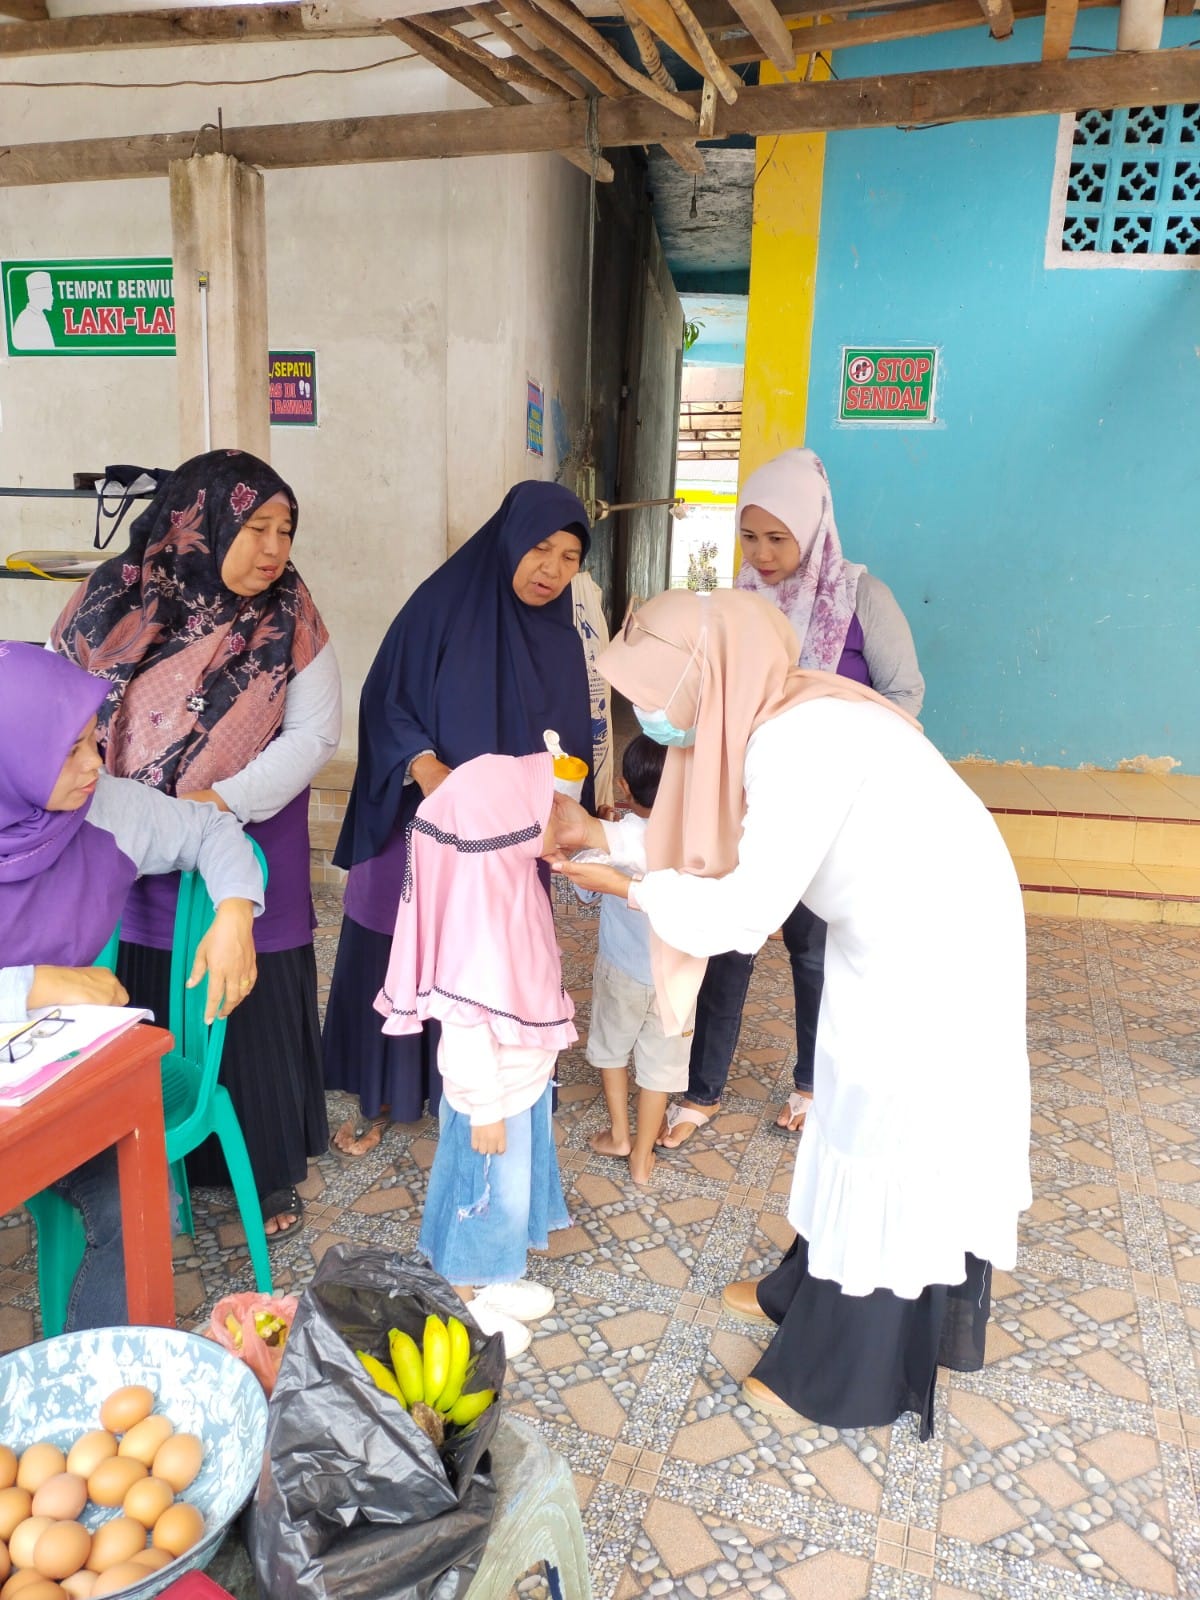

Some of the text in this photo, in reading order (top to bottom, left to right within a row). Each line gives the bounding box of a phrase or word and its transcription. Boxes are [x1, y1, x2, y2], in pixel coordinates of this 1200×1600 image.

[57, 279, 174, 299] TEMPAT BERWU
[876, 357, 931, 383] STOP
[846, 386, 927, 411] SENDAL
